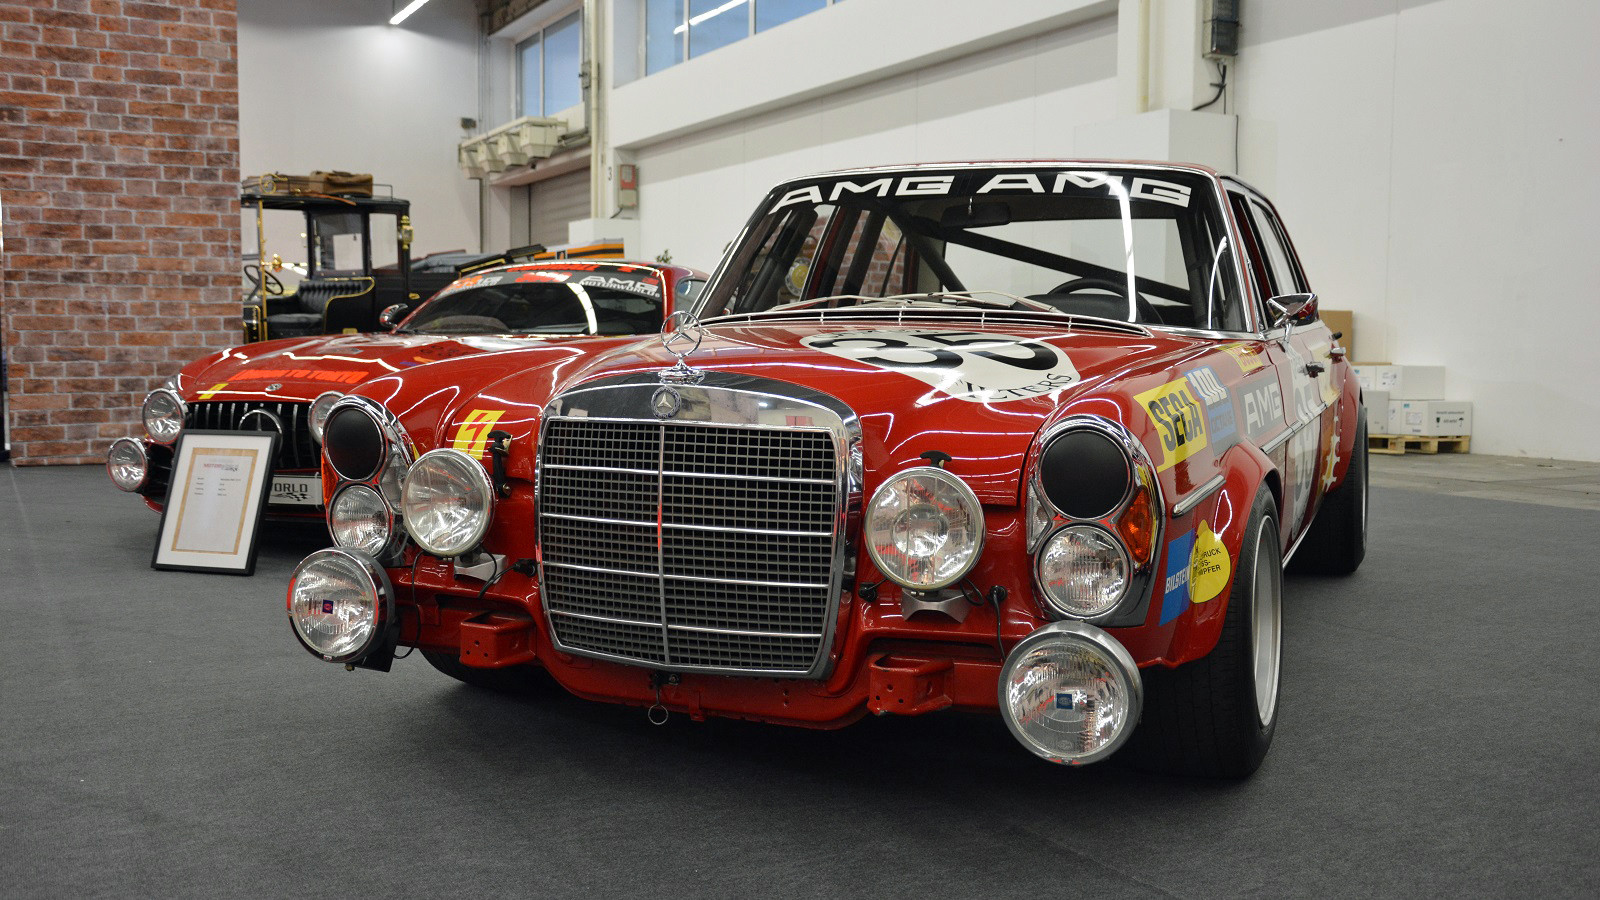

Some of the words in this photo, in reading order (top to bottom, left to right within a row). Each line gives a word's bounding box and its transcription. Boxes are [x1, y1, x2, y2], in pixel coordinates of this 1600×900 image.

[767, 175, 955, 214] AMG
[976, 173, 1192, 208] AMG
[808, 332, 1058, 371] 35
[1187, 368, 1227, 406] 100
[1244, 382, 1283, 435] AMG
[272, 482, 308, 493] ORLD
